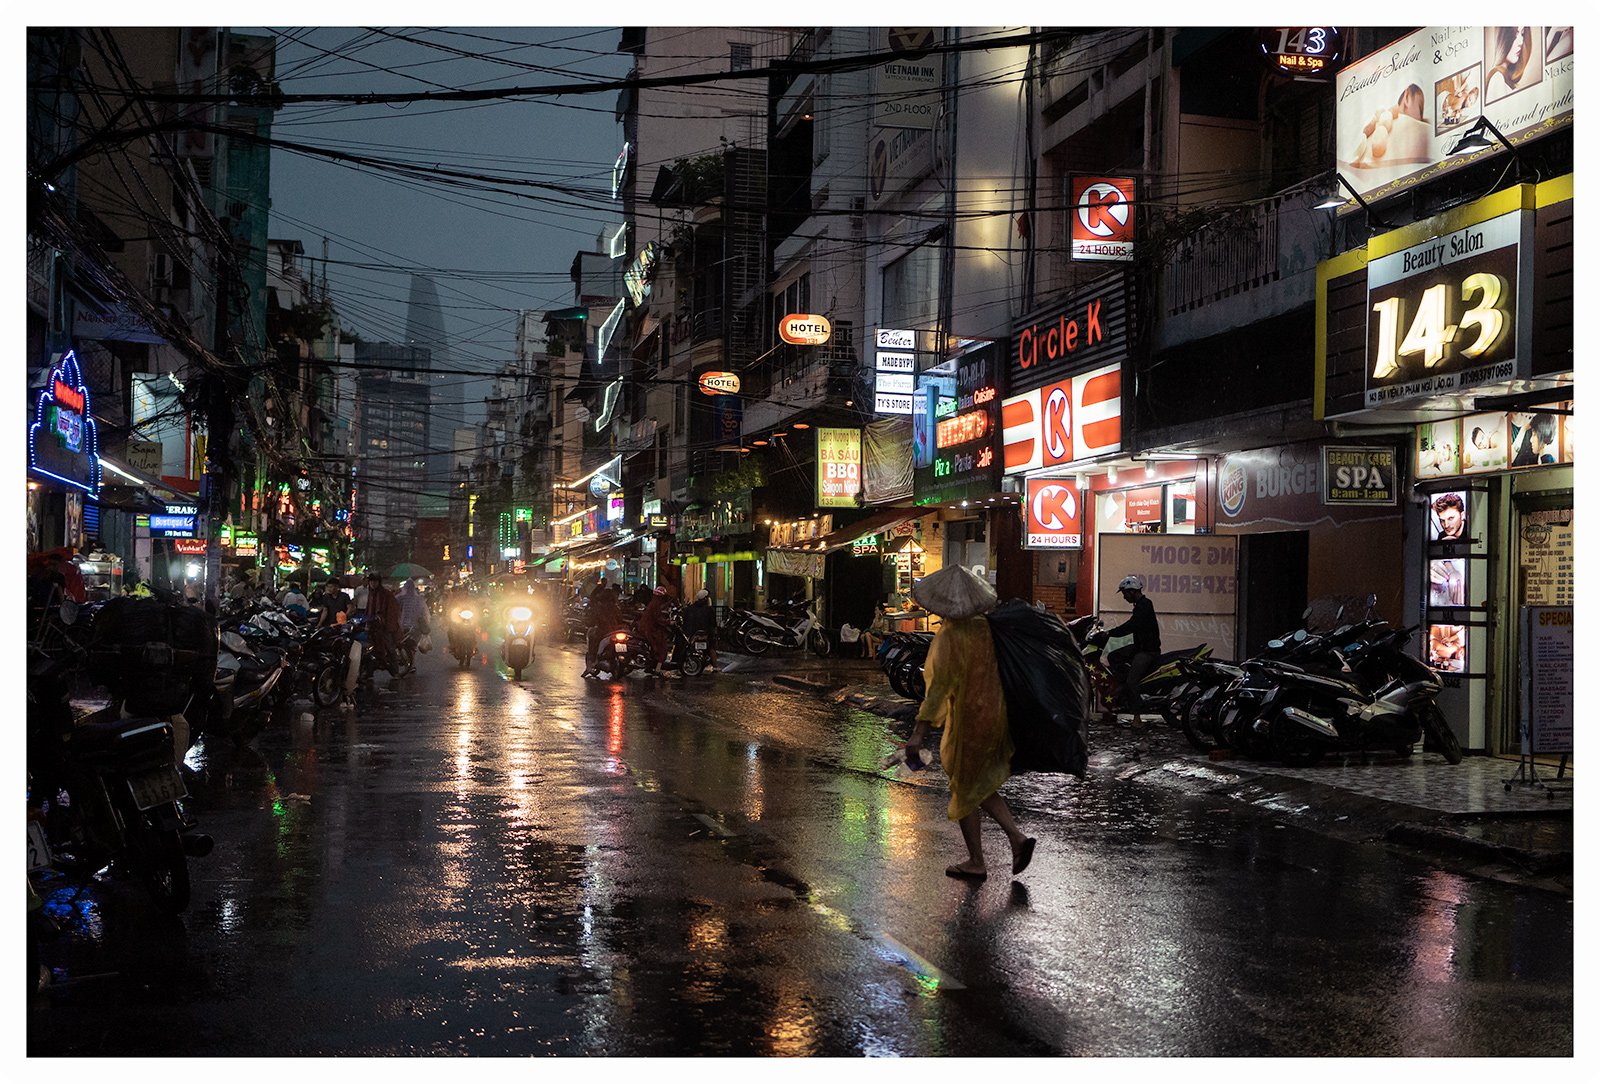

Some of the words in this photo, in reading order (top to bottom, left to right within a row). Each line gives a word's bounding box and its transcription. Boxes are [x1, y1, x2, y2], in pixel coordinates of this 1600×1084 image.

[1275, 27, 1327, 54] 143
[1430, 28, 1450, 48] Nail
[1433, 50, 1443, 65] &
[1444, 39, 1469, 58] Spa
[1279, 55, 1297, 66] Nail
[1298, 56, 1306, 66] &
[1307, 58, 1324, 68] Spa
[884, 64, 919, 77] VIETNAM
[920, 67, 935, 78] INK
[1340, 67, 1383, 102] Beauty
[1383, 44, 1421, 79] Salon
[884, 102, 902, 113] 2ND
[904, 104, 932, 115] FLOOR
[1511, 103, 1539, 127] and
[1080, 244, 1091, 254] 24
[1094, 245, 1127, 256] HOURS
[1402, 244, 1446, 274] Beauty
[1450, 229, 1484, 258] Salon
[790, 323, 828, 333] HOTEL
[1020, 315, 1078, 369] Circle
[1087, 298, 1102, 346] K
[1373, 273, 1506, 379] 143
[707, 379, 737, 388] HOTEL
[877, 398, 891, 408] TY'S
[892, 400, 910, 409] STORE
[974, 386, 996, 405] Cuisine
[131, 444, 156, 458] Sapa
[1329, 452, 1365, 466] BEAUTY
[1368, 452, 1392, 467] CARE
[827, 463, 858, 480] BBQ
[1223, 467, 1243, 489] BURGER
[1336, 466, 1386, 489] SPA
[822, 480, 843, 496] Saigon
[843, 480, 860, 497] Night
[1223, 477, 1244, 504] KING
[821, 498, 834, 506] 135
[155, 516, 182, 527] Boutique
[1031, 536, 1042, 544] 24
[1044, 536, 1077, 544] HOURS
[852, 545, 879, 555] SPA
